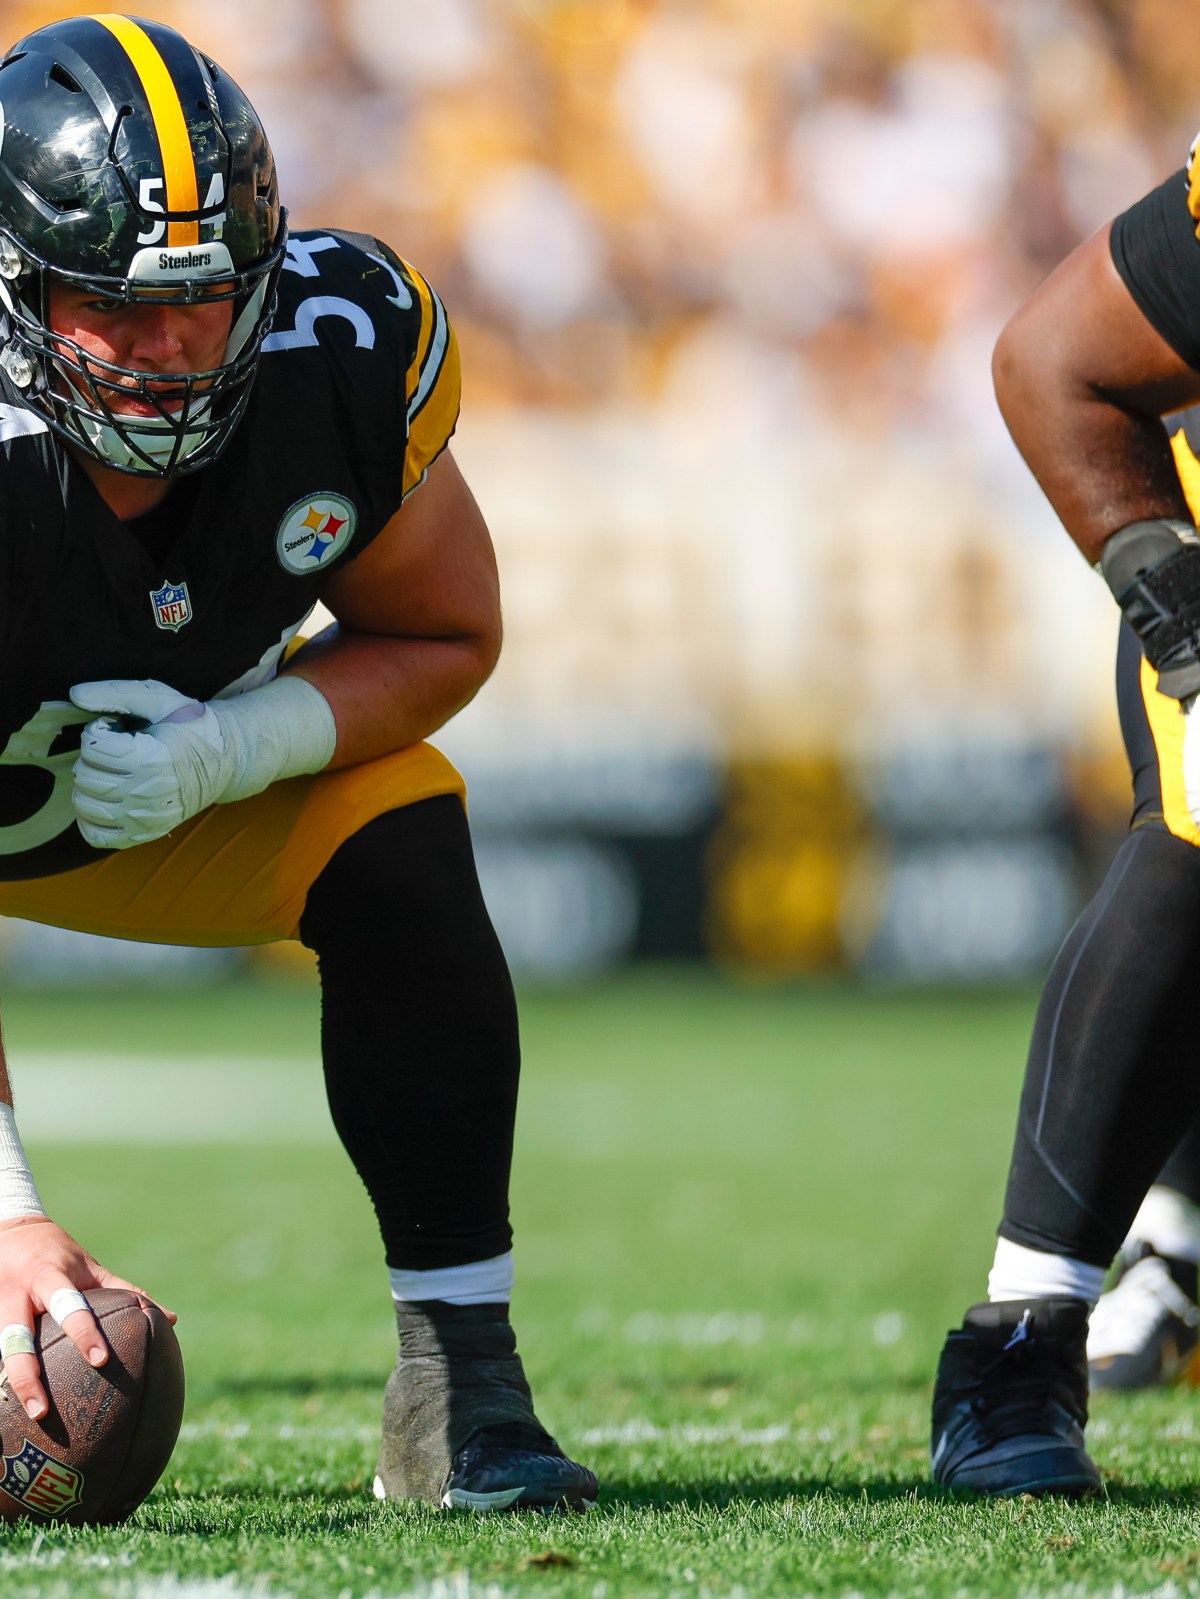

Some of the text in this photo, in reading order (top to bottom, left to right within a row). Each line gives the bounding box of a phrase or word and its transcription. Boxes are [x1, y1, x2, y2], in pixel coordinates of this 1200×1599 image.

[137, 173, 227, 245] 54
[159, 251, 211, 270] Steelers
[261, 236, 376, 353] 54
[284, 532, 315, 552] Steelers
[160, 602, 187, 623] NFL
[25, 1467, 76, 1513] NFL
